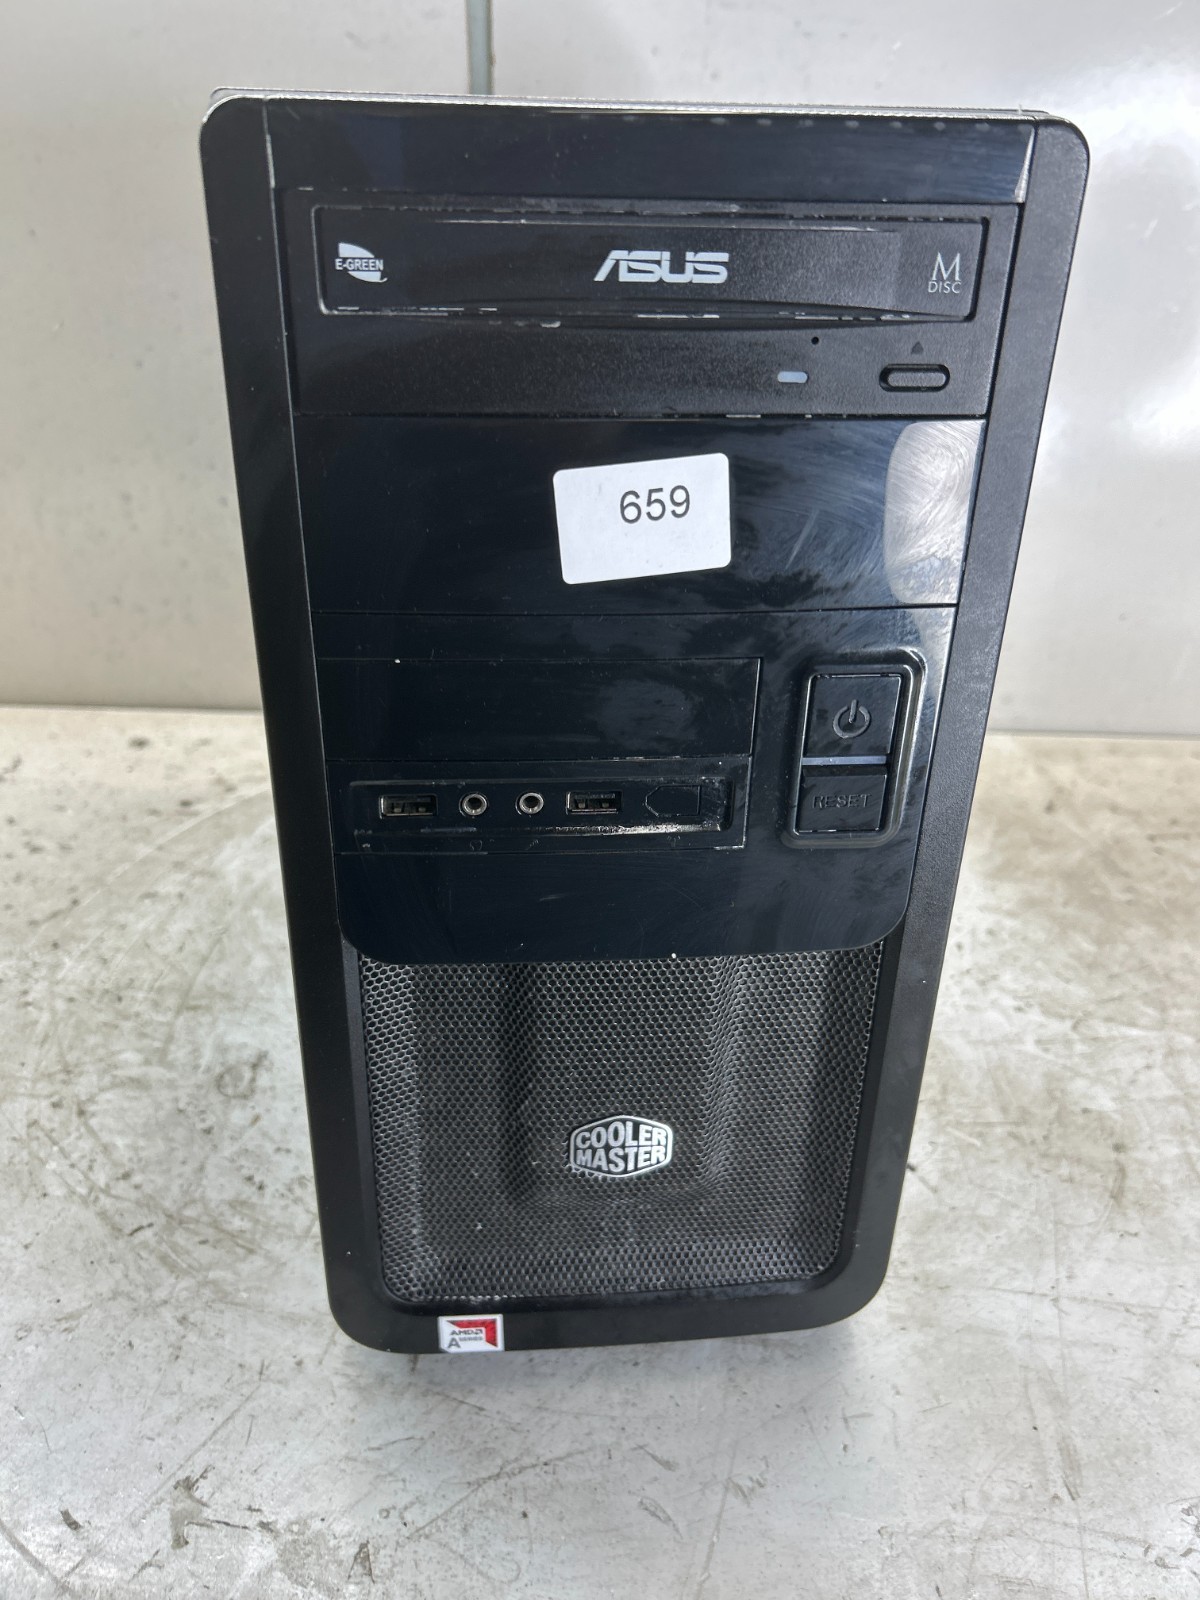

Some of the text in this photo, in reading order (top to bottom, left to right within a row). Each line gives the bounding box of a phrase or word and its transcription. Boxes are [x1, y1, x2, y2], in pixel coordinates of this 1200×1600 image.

[335, 258, 384, 271] E-GREEN
[594, 250, 729, 284] ASUS
[931, 251, 961, 281] M
[928, 281, 961, 294] DISC
[620, 485, 690, 524] 659
[812, 794, 872, 809] RESET
[575, 1121, 667, 1149] COOLER
[575, 1145, 666, 1173] MASTER
